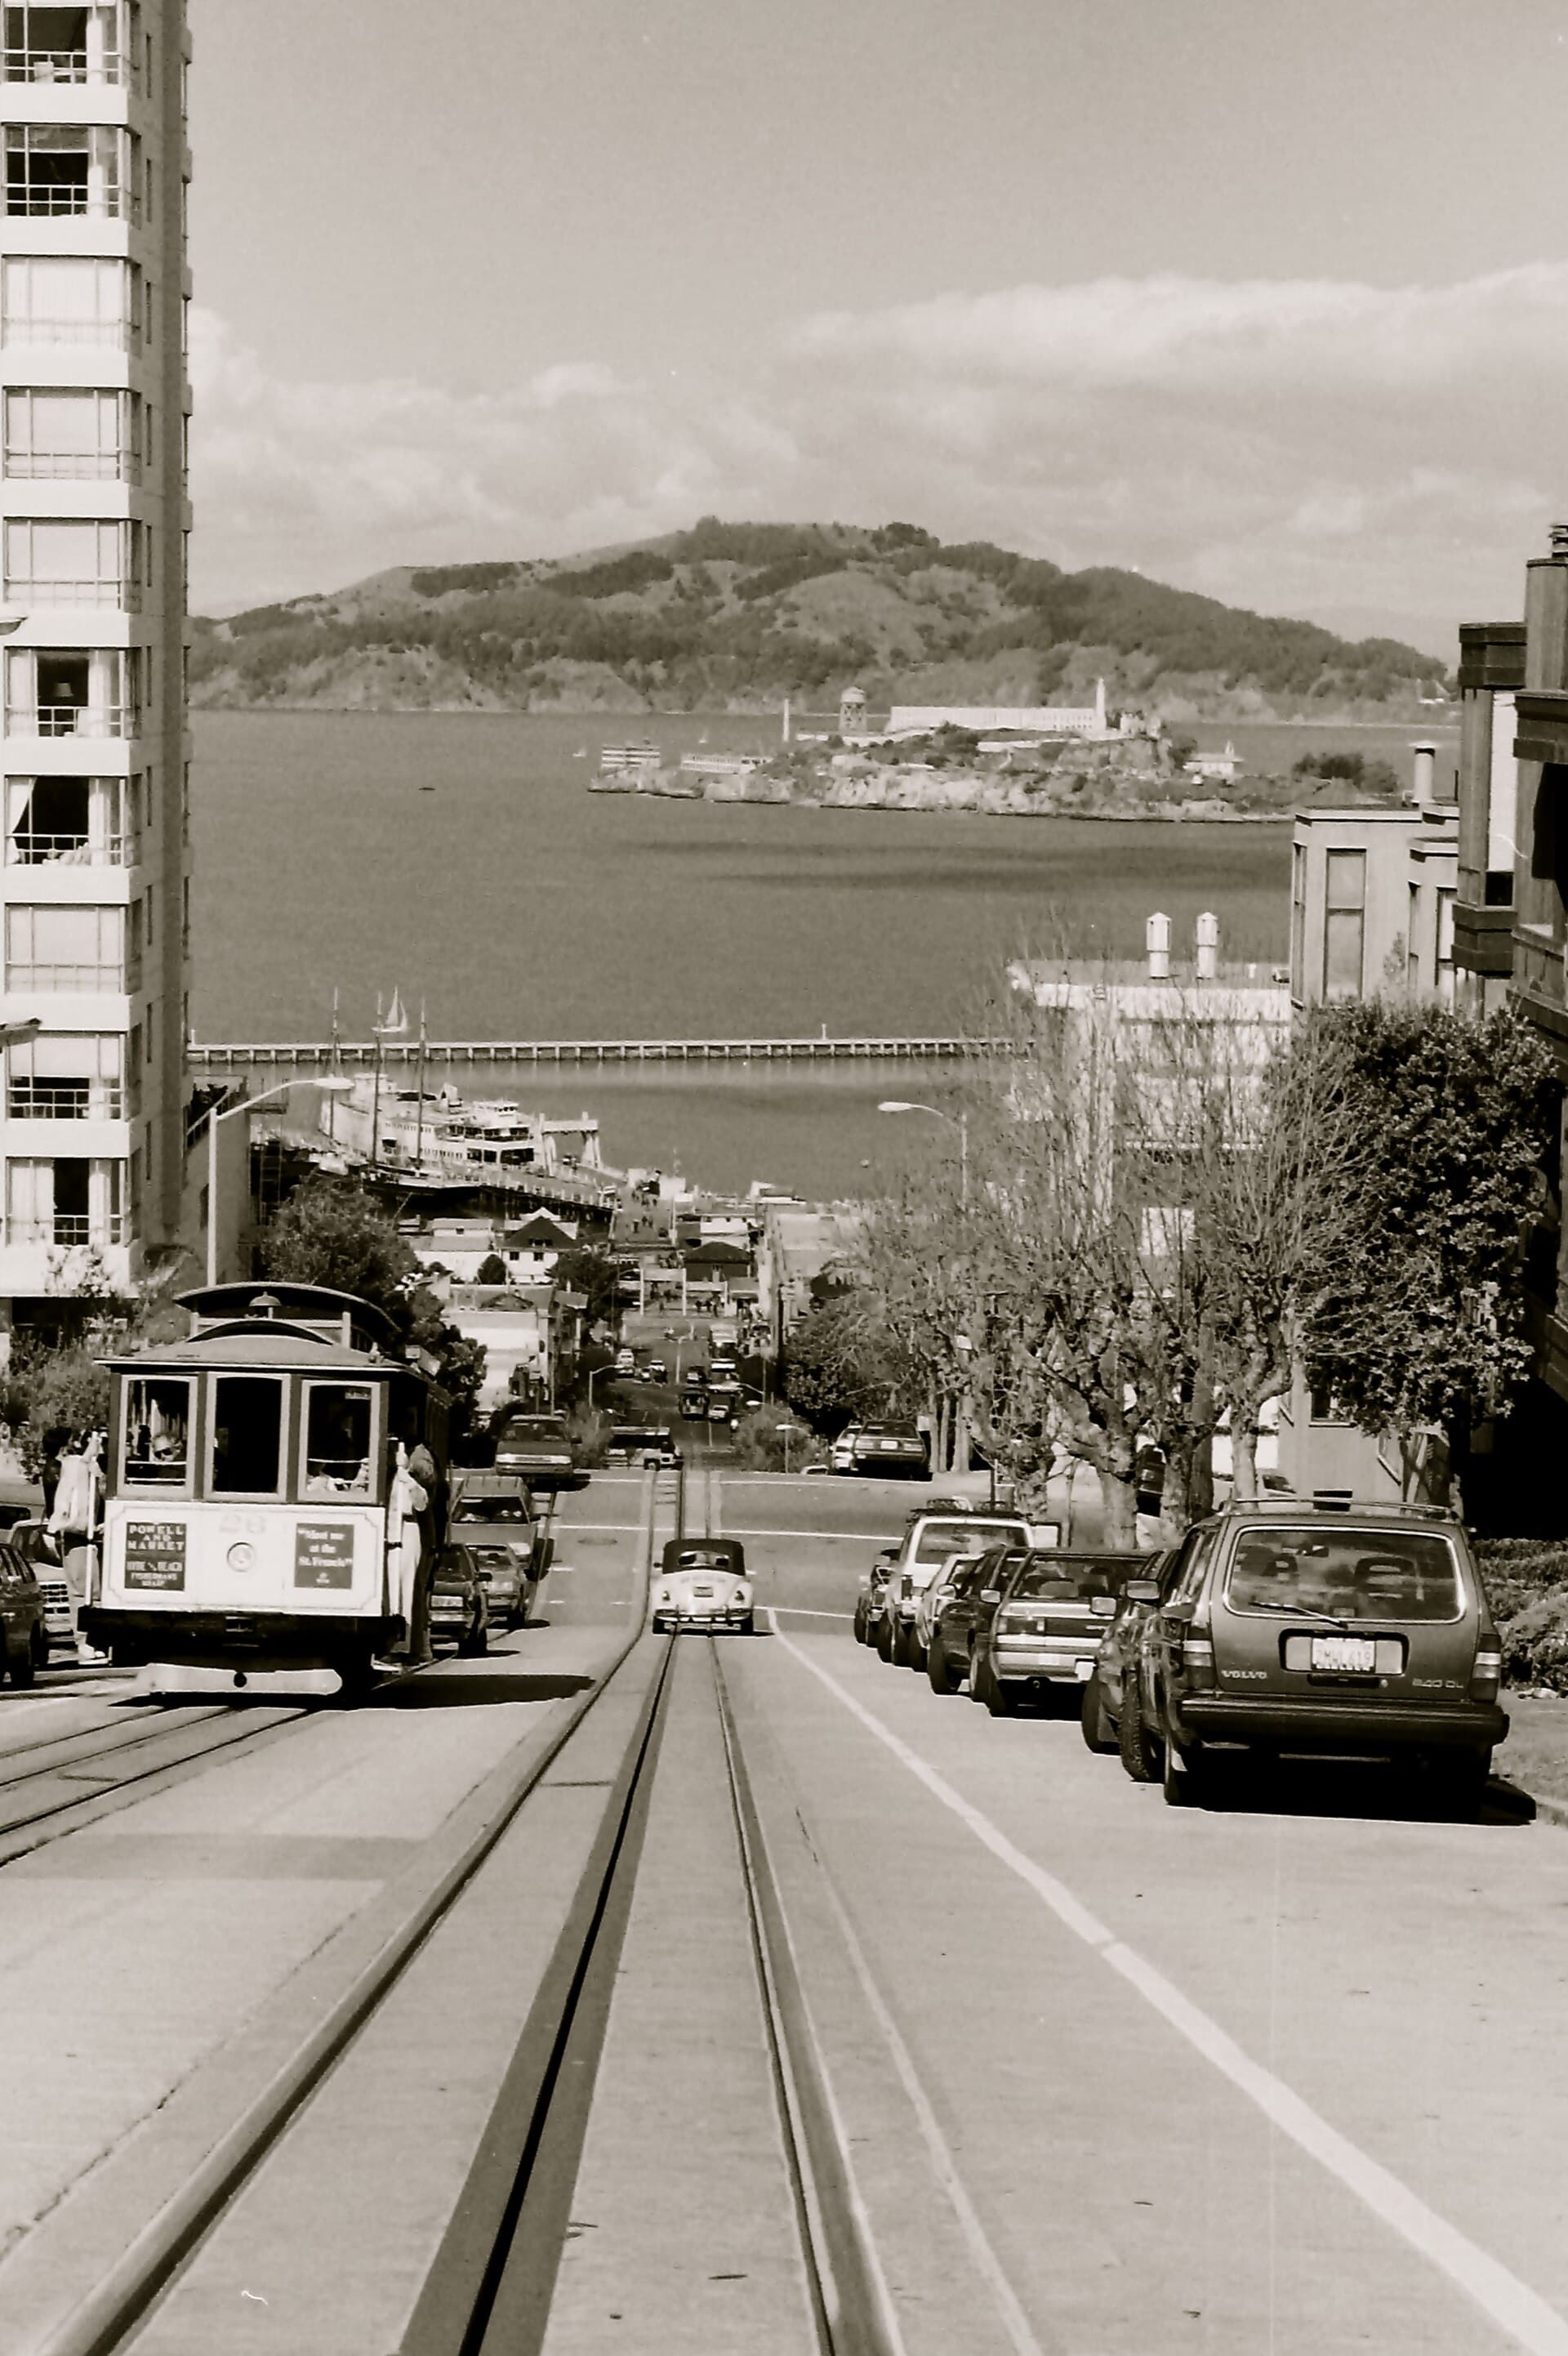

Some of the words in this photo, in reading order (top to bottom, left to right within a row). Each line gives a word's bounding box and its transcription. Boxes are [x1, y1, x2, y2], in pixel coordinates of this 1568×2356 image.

[129, 1524, 184, 1535] POWELL
[127, 1540, 185, 1551] MARKET
[1221, 1670, 1267, 1680] VOLVO
